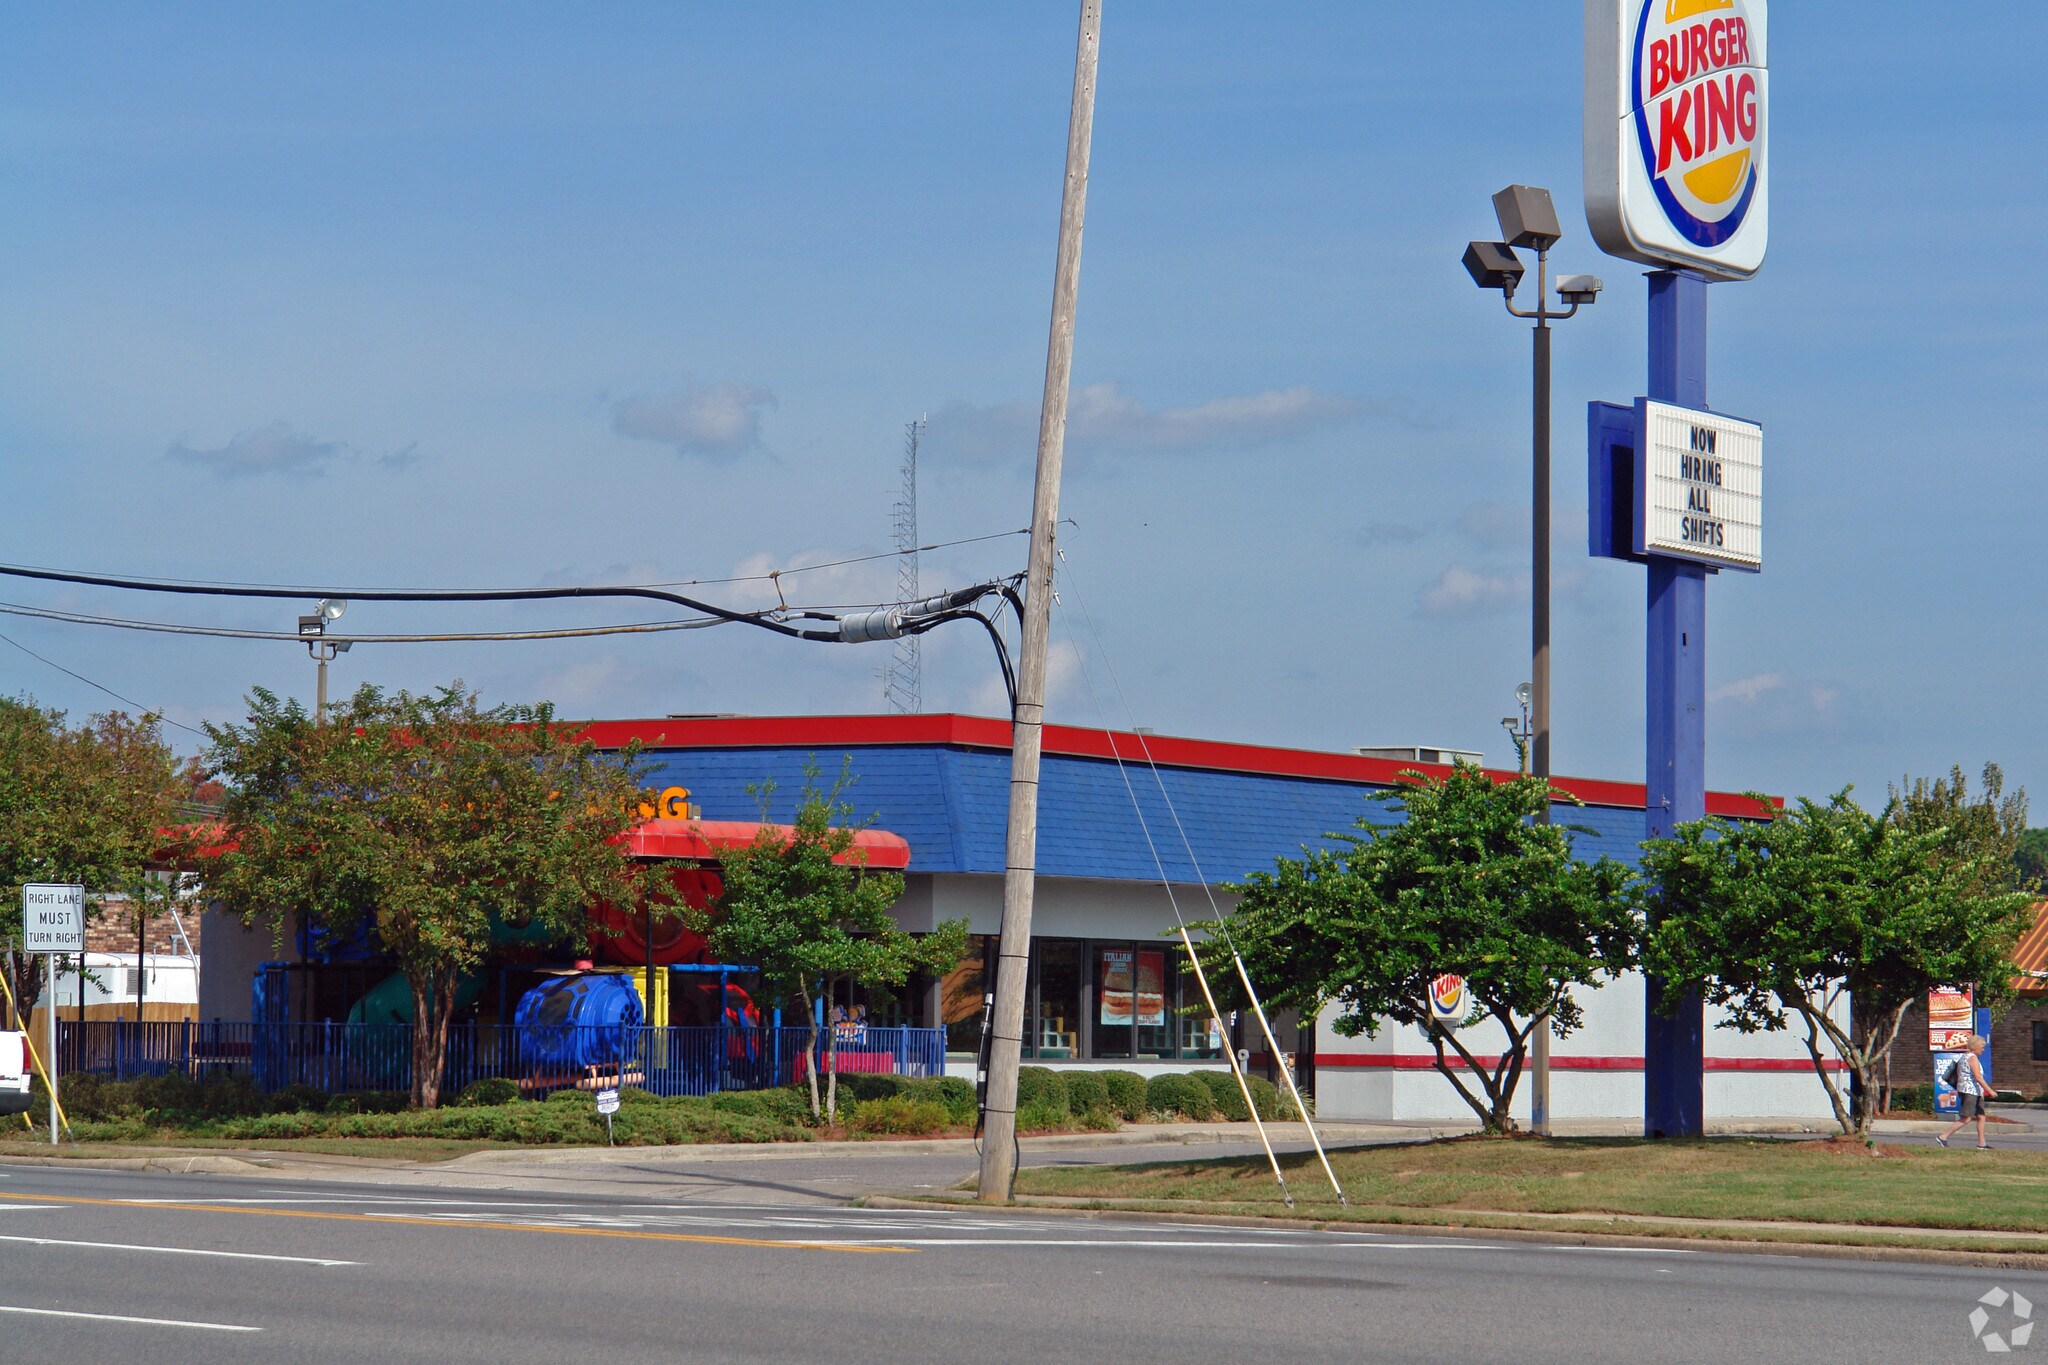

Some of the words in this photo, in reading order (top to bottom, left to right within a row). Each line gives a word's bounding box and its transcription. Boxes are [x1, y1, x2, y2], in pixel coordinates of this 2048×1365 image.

[1650, 16, 1750, 98] BURGER
[1657, 73, 1757, 174] KING
[1691, 425, 1717, 454] NOW
[1681, 454, 1722, 486] HIRING
[1688, 487, 1711, 513] ALL
[1681, 516, 1724, 546] SHIFTS
[28, 893, 54, 904] RIGHT
[57, 894, 81, 905] LANE
[39, 911, 71, 925] MUST
[28, 932, 52, 943] TURN
[56, 932, 82, 943] RIGHT
[1103, 952, 1132, 963] ITALIAN
